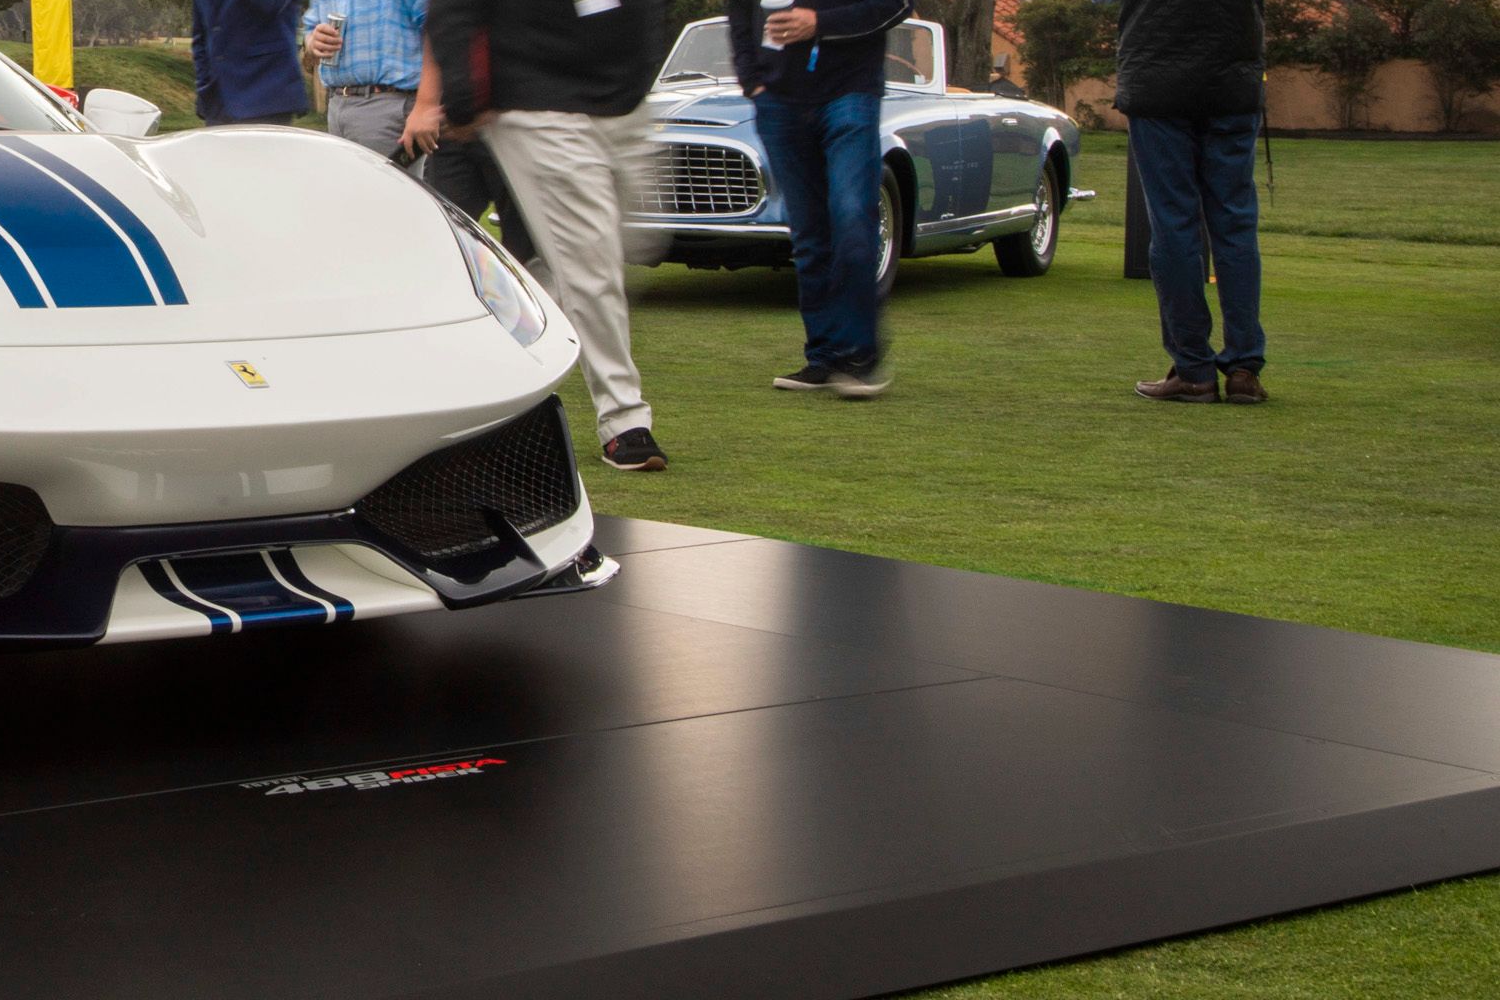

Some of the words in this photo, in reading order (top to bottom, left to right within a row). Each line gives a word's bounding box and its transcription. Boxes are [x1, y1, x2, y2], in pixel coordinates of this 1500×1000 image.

[265, 771, 390, 796] 488
[389, 758, 507, 780] PISTA
[354, 767, 485, 791] SPIDER
